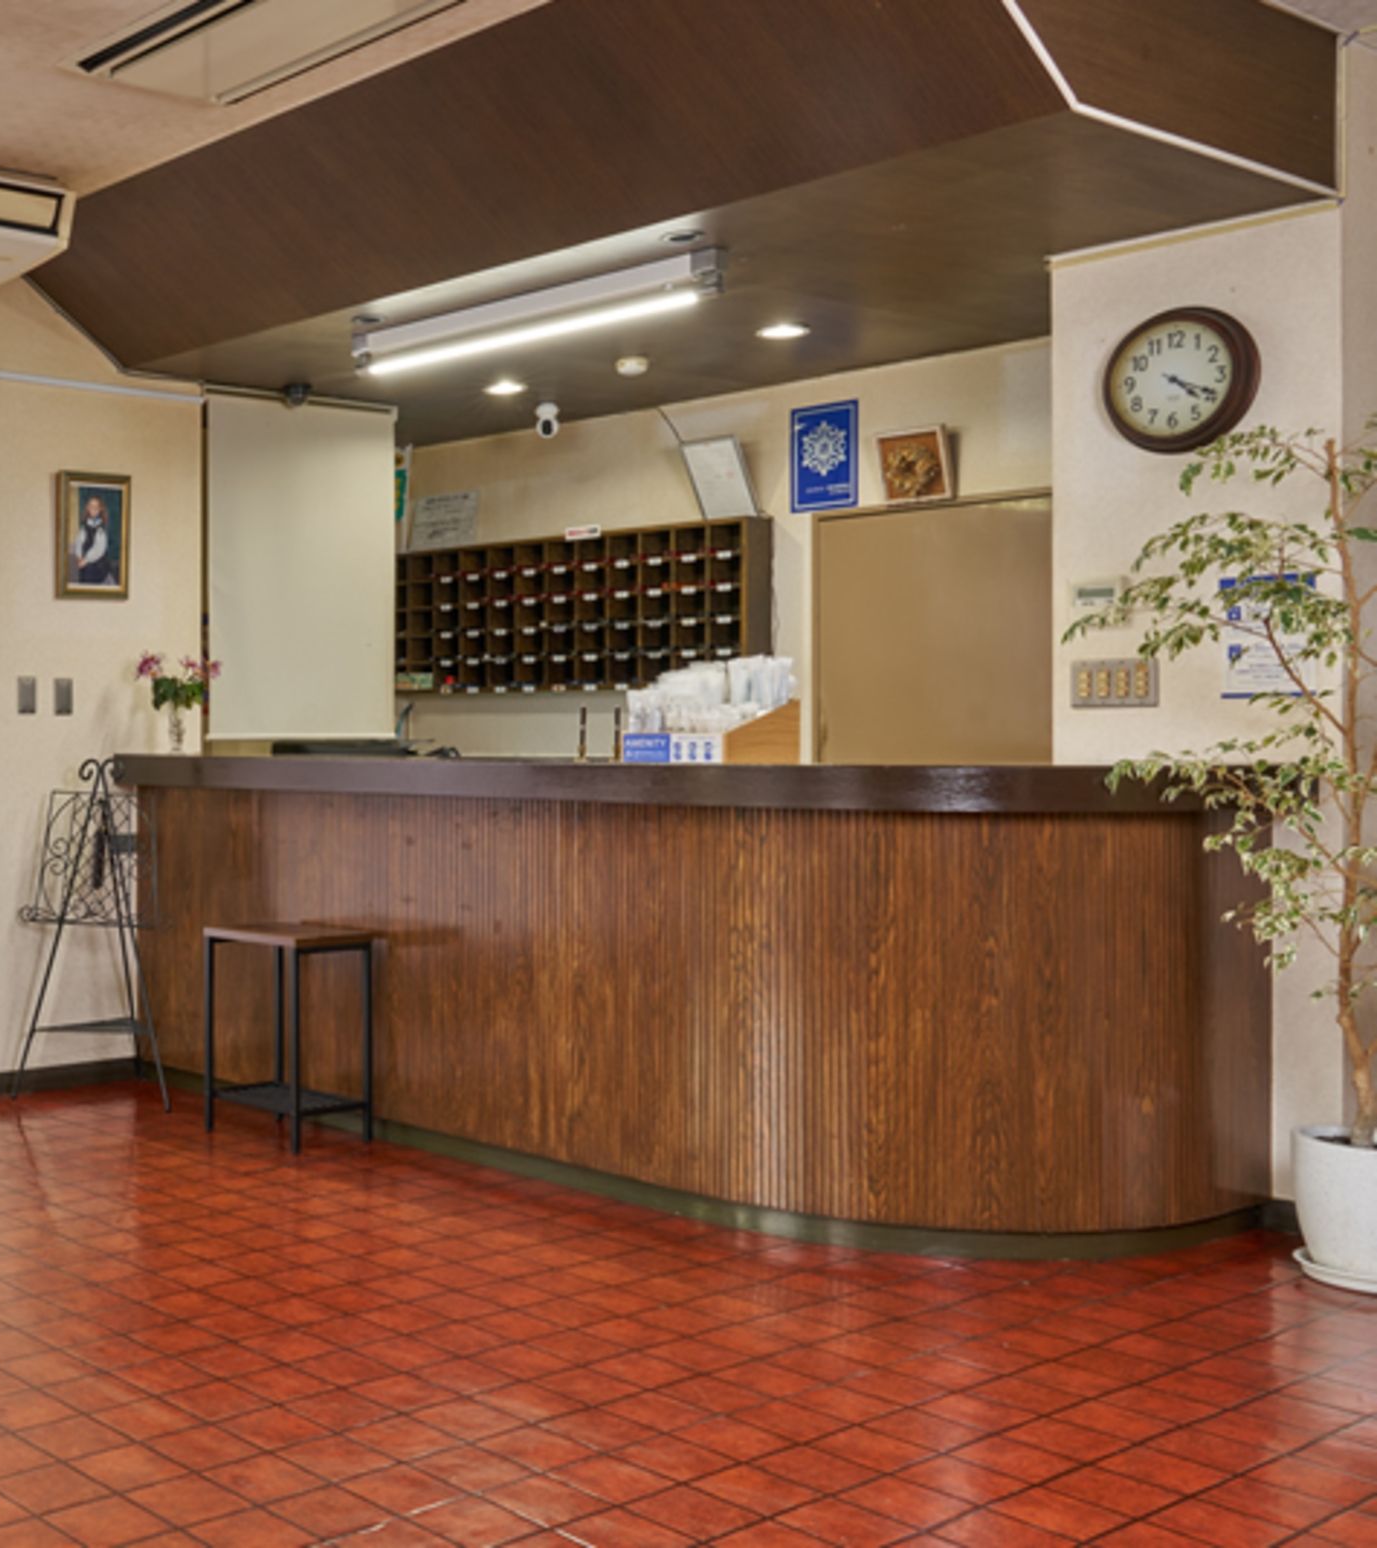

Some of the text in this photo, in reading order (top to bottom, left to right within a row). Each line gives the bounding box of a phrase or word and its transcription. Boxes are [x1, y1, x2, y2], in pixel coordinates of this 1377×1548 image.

[1148, 338, 1162, 356] 11
[1167, 330, 1185, 349] 12
[1194, 333, 1201, 350] 1
[1207, 345, 1219, 363] 2
[1132, 355, 1149, 372] 10
[1214, 365, 1227, 383] 3
[1124, 376, 1136, 394] 9
[1131, 396, 1143, 412] 8
[1190, 404, 1202, 421] 5
[1148, 408, 1159, 424] 7
[1167, 411, 1178, 428] 6
